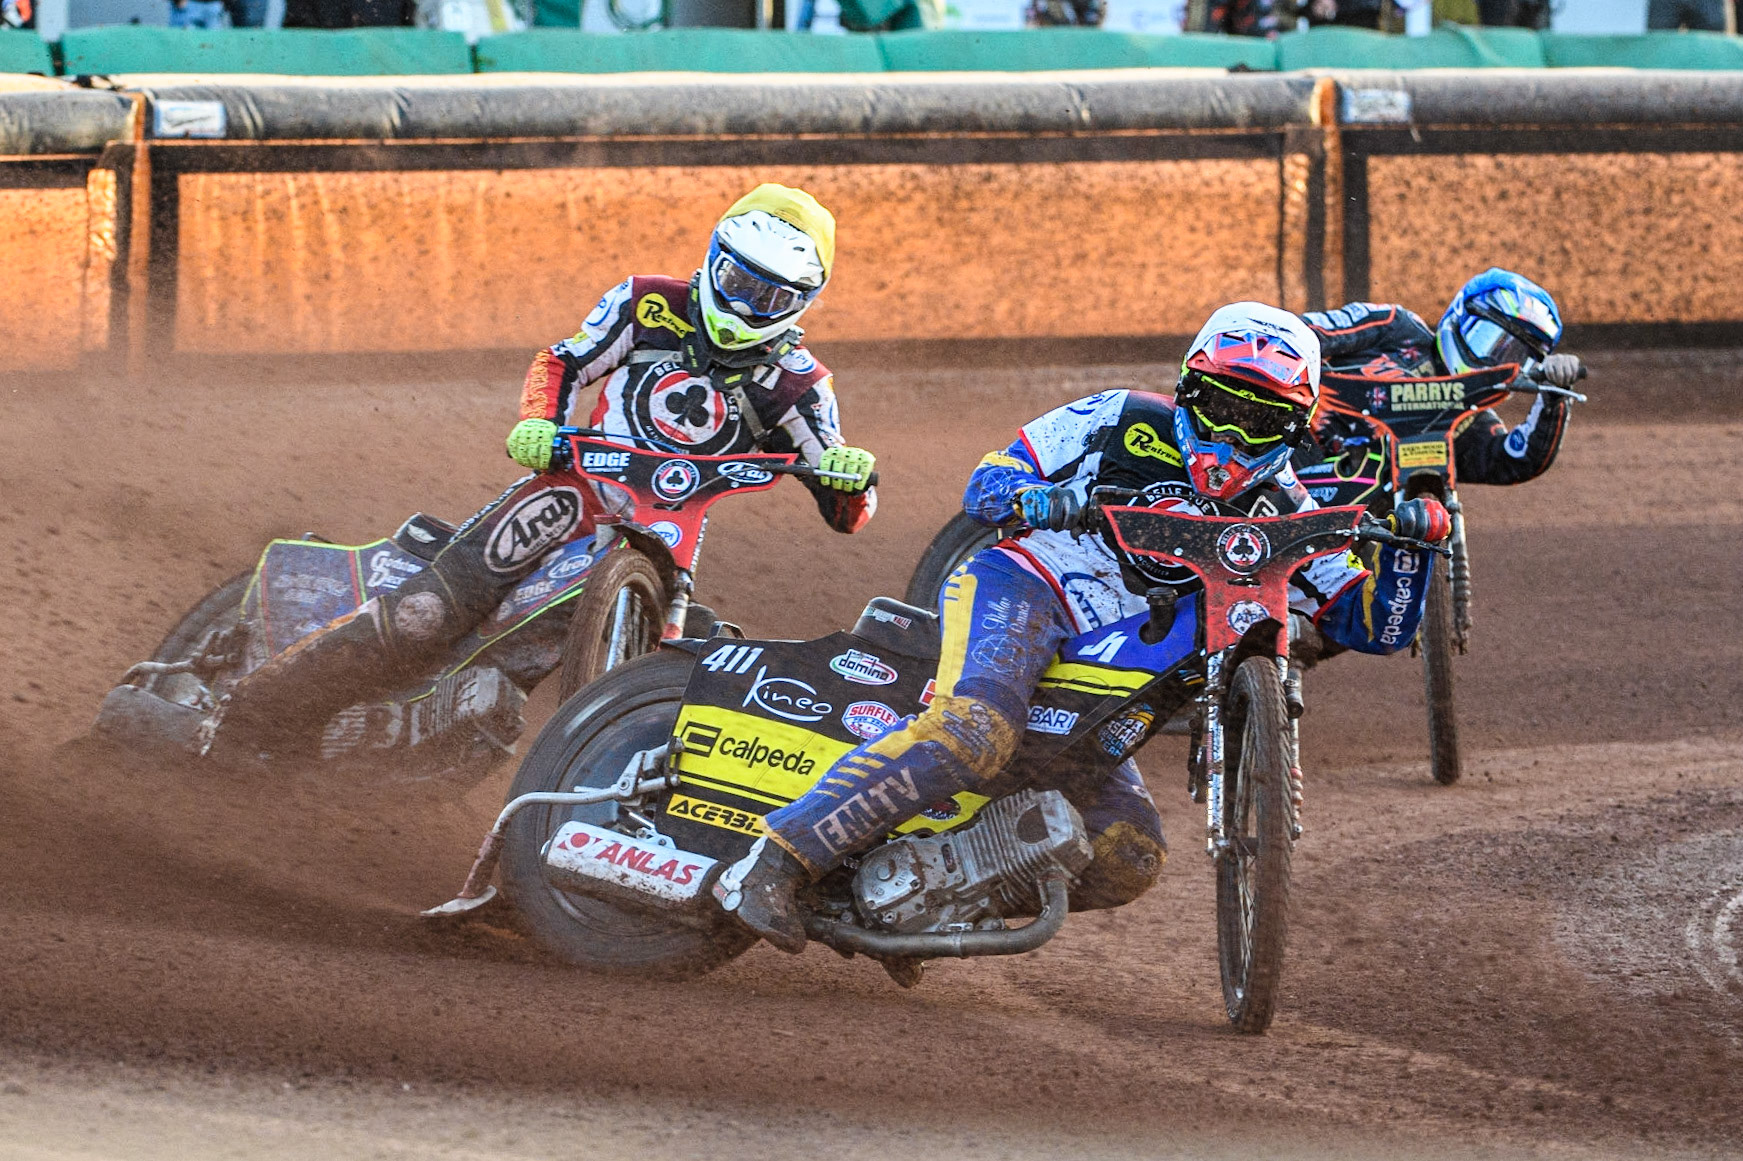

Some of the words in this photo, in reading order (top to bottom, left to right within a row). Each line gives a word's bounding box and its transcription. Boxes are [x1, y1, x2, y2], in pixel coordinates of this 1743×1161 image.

[1390, 382, 1465, 403] PARRYS
[581, 452, 632, 467] EDGE
[499, 495, 571, 565] Arai
[1380, 577, 1413, 645] calpeda
[701, 644, 764, 674] 411
[838, 651, 890, 683] domino
[718, 735, 816, 776] calpeda
[596, 842, 704, 886] ANLAS
